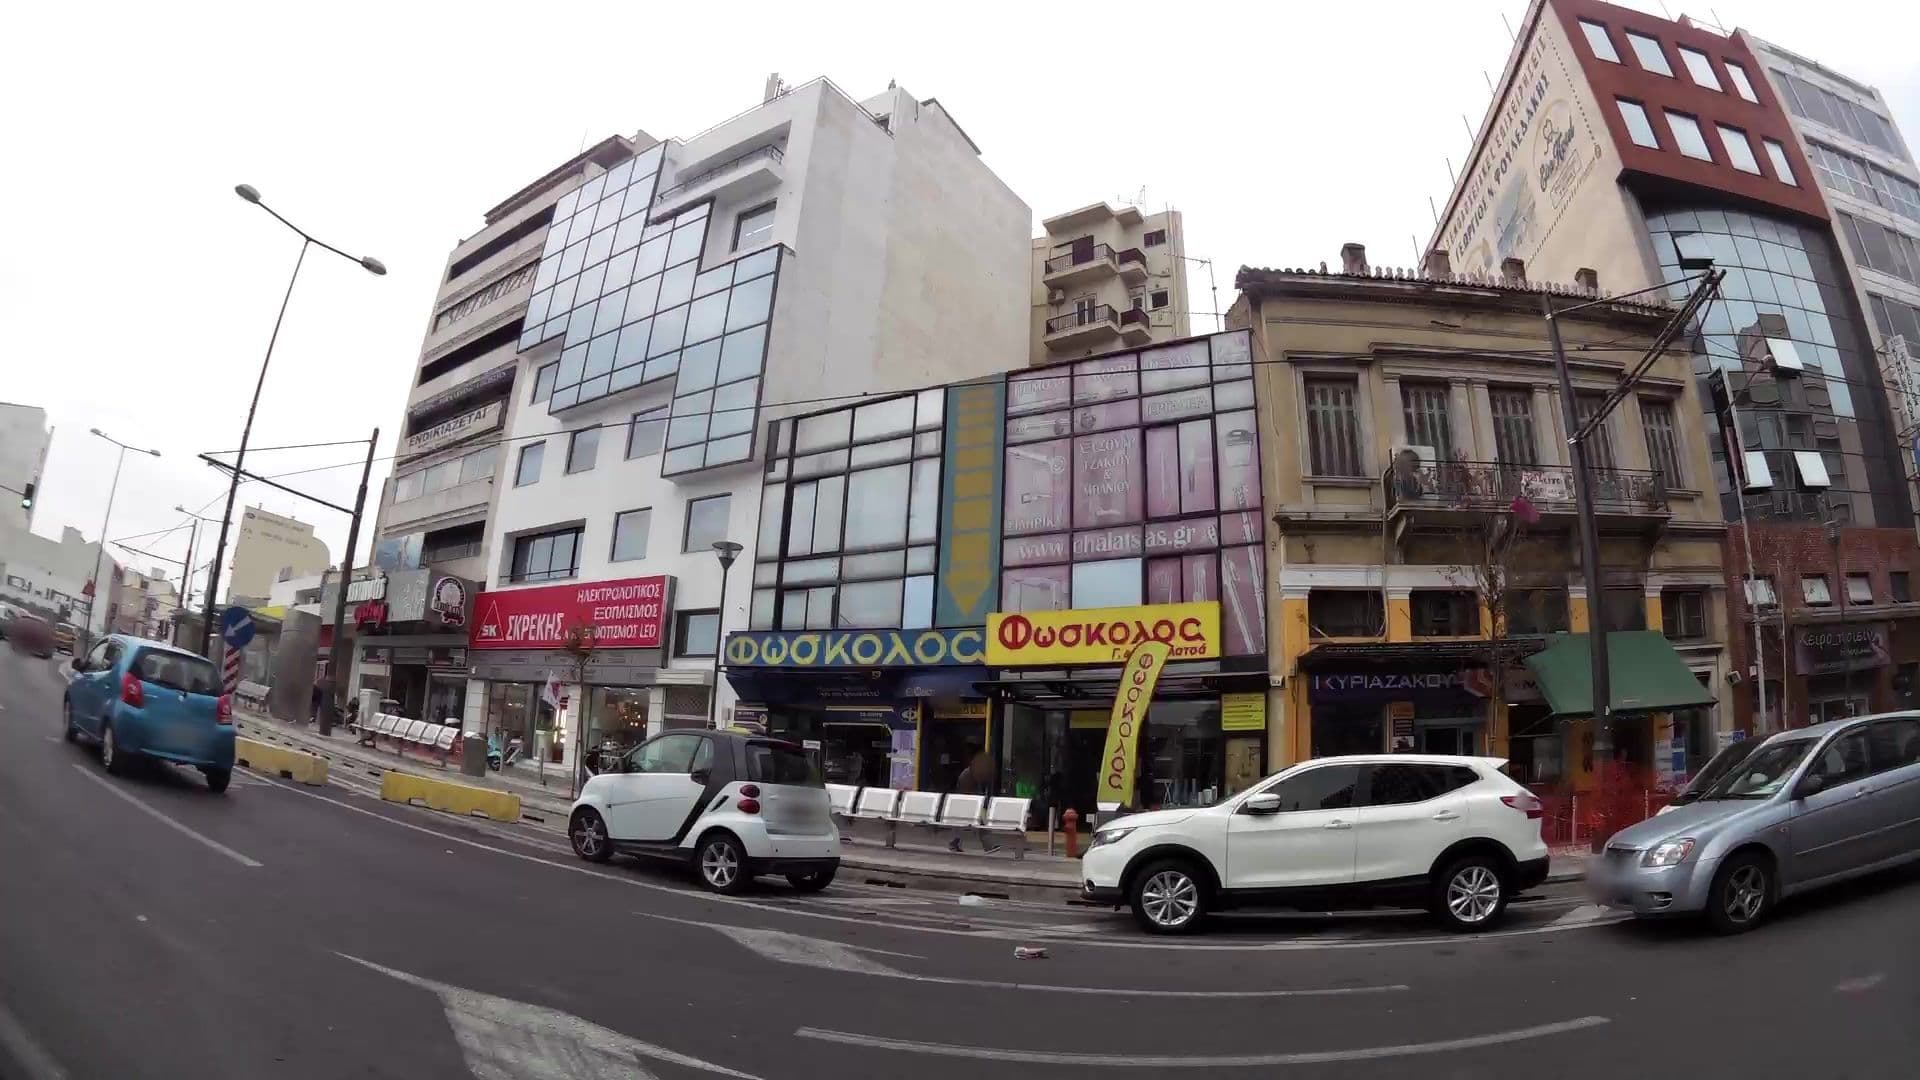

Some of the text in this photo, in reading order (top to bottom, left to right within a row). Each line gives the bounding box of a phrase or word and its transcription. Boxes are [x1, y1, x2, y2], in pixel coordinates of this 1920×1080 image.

[577, 583, 662, 603] ΗΛΕΚΤΡΟΛΟΓΙΚΟΣ
[594, 604, 658, 620] ΕΞΟΠΛΙΣΜΟΣ
[481, 624, 497, 637] SK
[505, 612, 565, 641] ΣΚΡΕΚΗΣ
